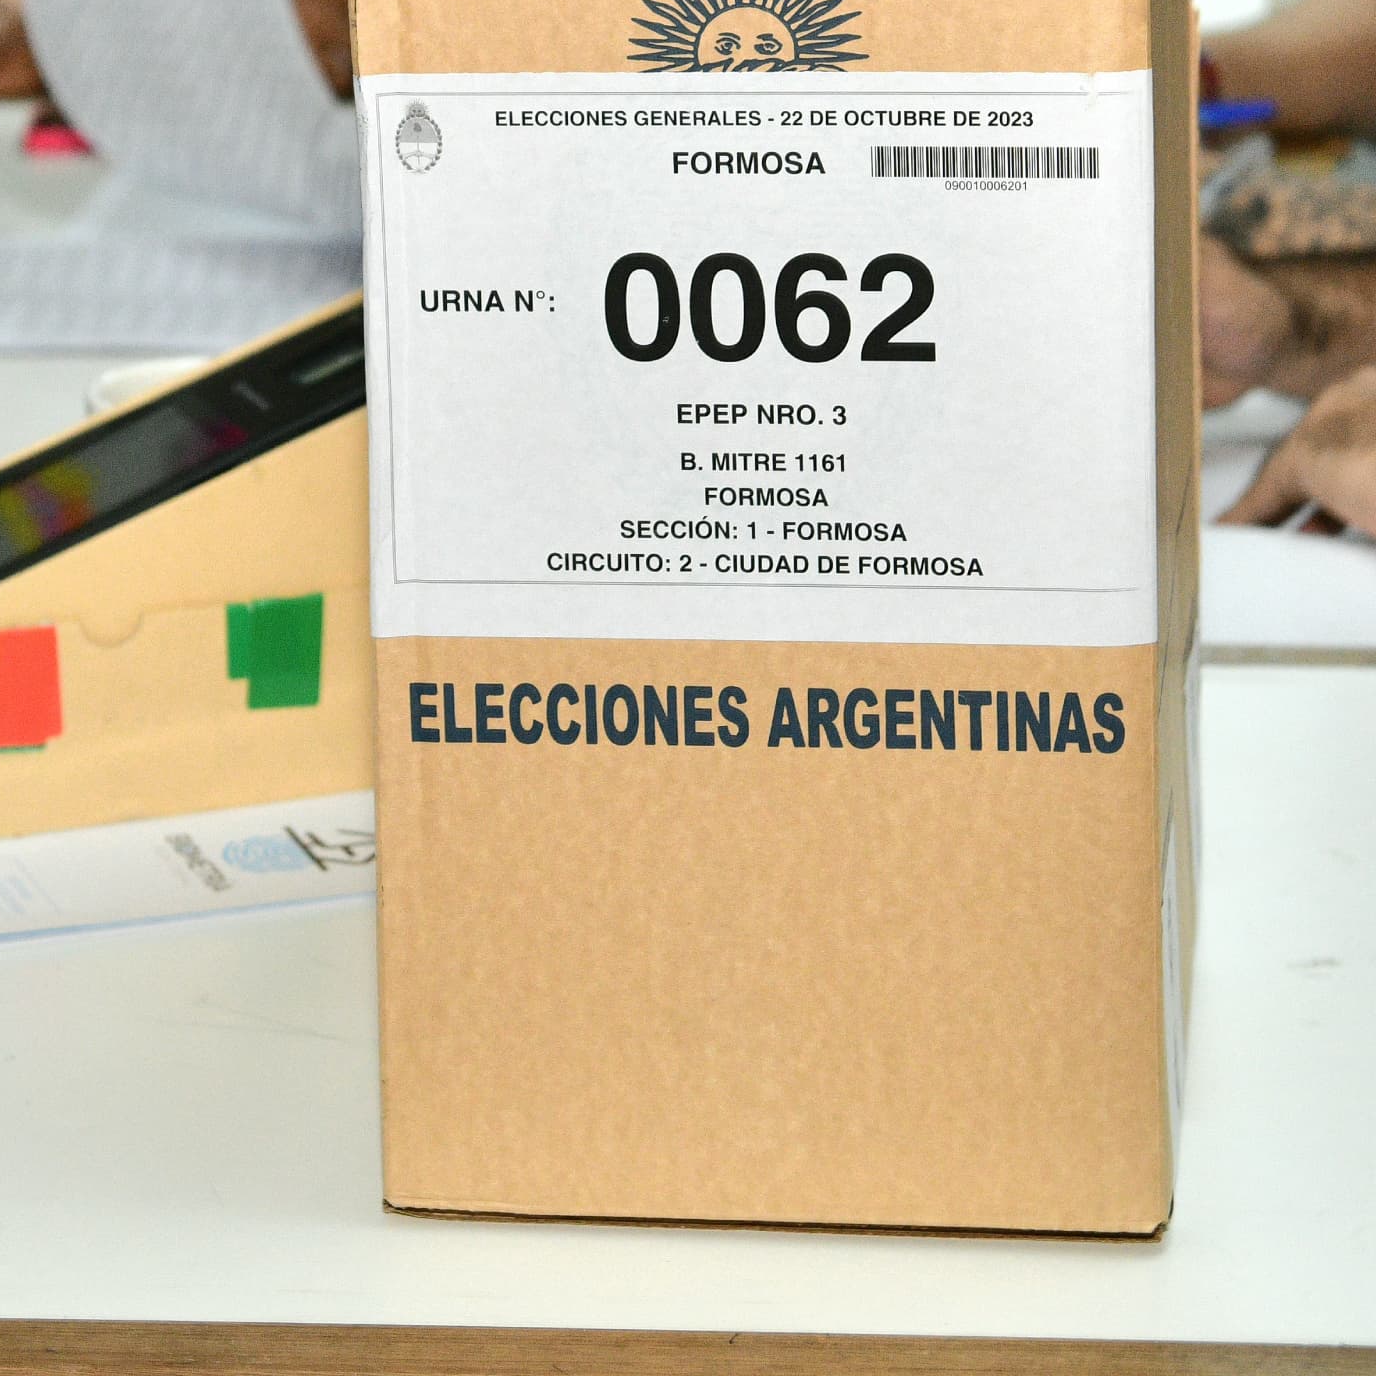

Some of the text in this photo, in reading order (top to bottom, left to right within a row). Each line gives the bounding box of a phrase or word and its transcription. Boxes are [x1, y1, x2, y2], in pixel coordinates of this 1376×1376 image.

[495, 110, 628, 127] ELECCIONES
[633, 110, 762, 127] GENERALES
[780, 110, 803, 126] 22
[810, 110, 838, 126] DE
[844, 110, 947, 127] OCTUBRE
[953, 110, 981, 127] DE
[987, 111, 1034, 127] 2023
[672, 151, 826, 175] FORMOSA
[944, 180, 1027, 191] 090010006201
[420, 289, 555, 313] URNA N°:
[604, 252, 937, 364] 0062
[677, 403, 847, 426] EPEP NRO. 3
[680, 452, 845, 473] B. MITRE 1161
[704, 486, 829, 507] FORMOSA
[620, 515, 738, 540] SECCIÓN:
[747, 521, 756, 540] 1
[782, 521, 908, 542] FORMOSA
[547, 552, 671, 573] CIRCUITO:
[679, 554, 693, 573] 2
[715, 553, 809, 574] CIUDAD
[817, 555, 850, 574] DE
[858, 556, 984, 577] FORMOSA
[409, 682, 1126, 754] ELECCIONES ARGENTINAS
